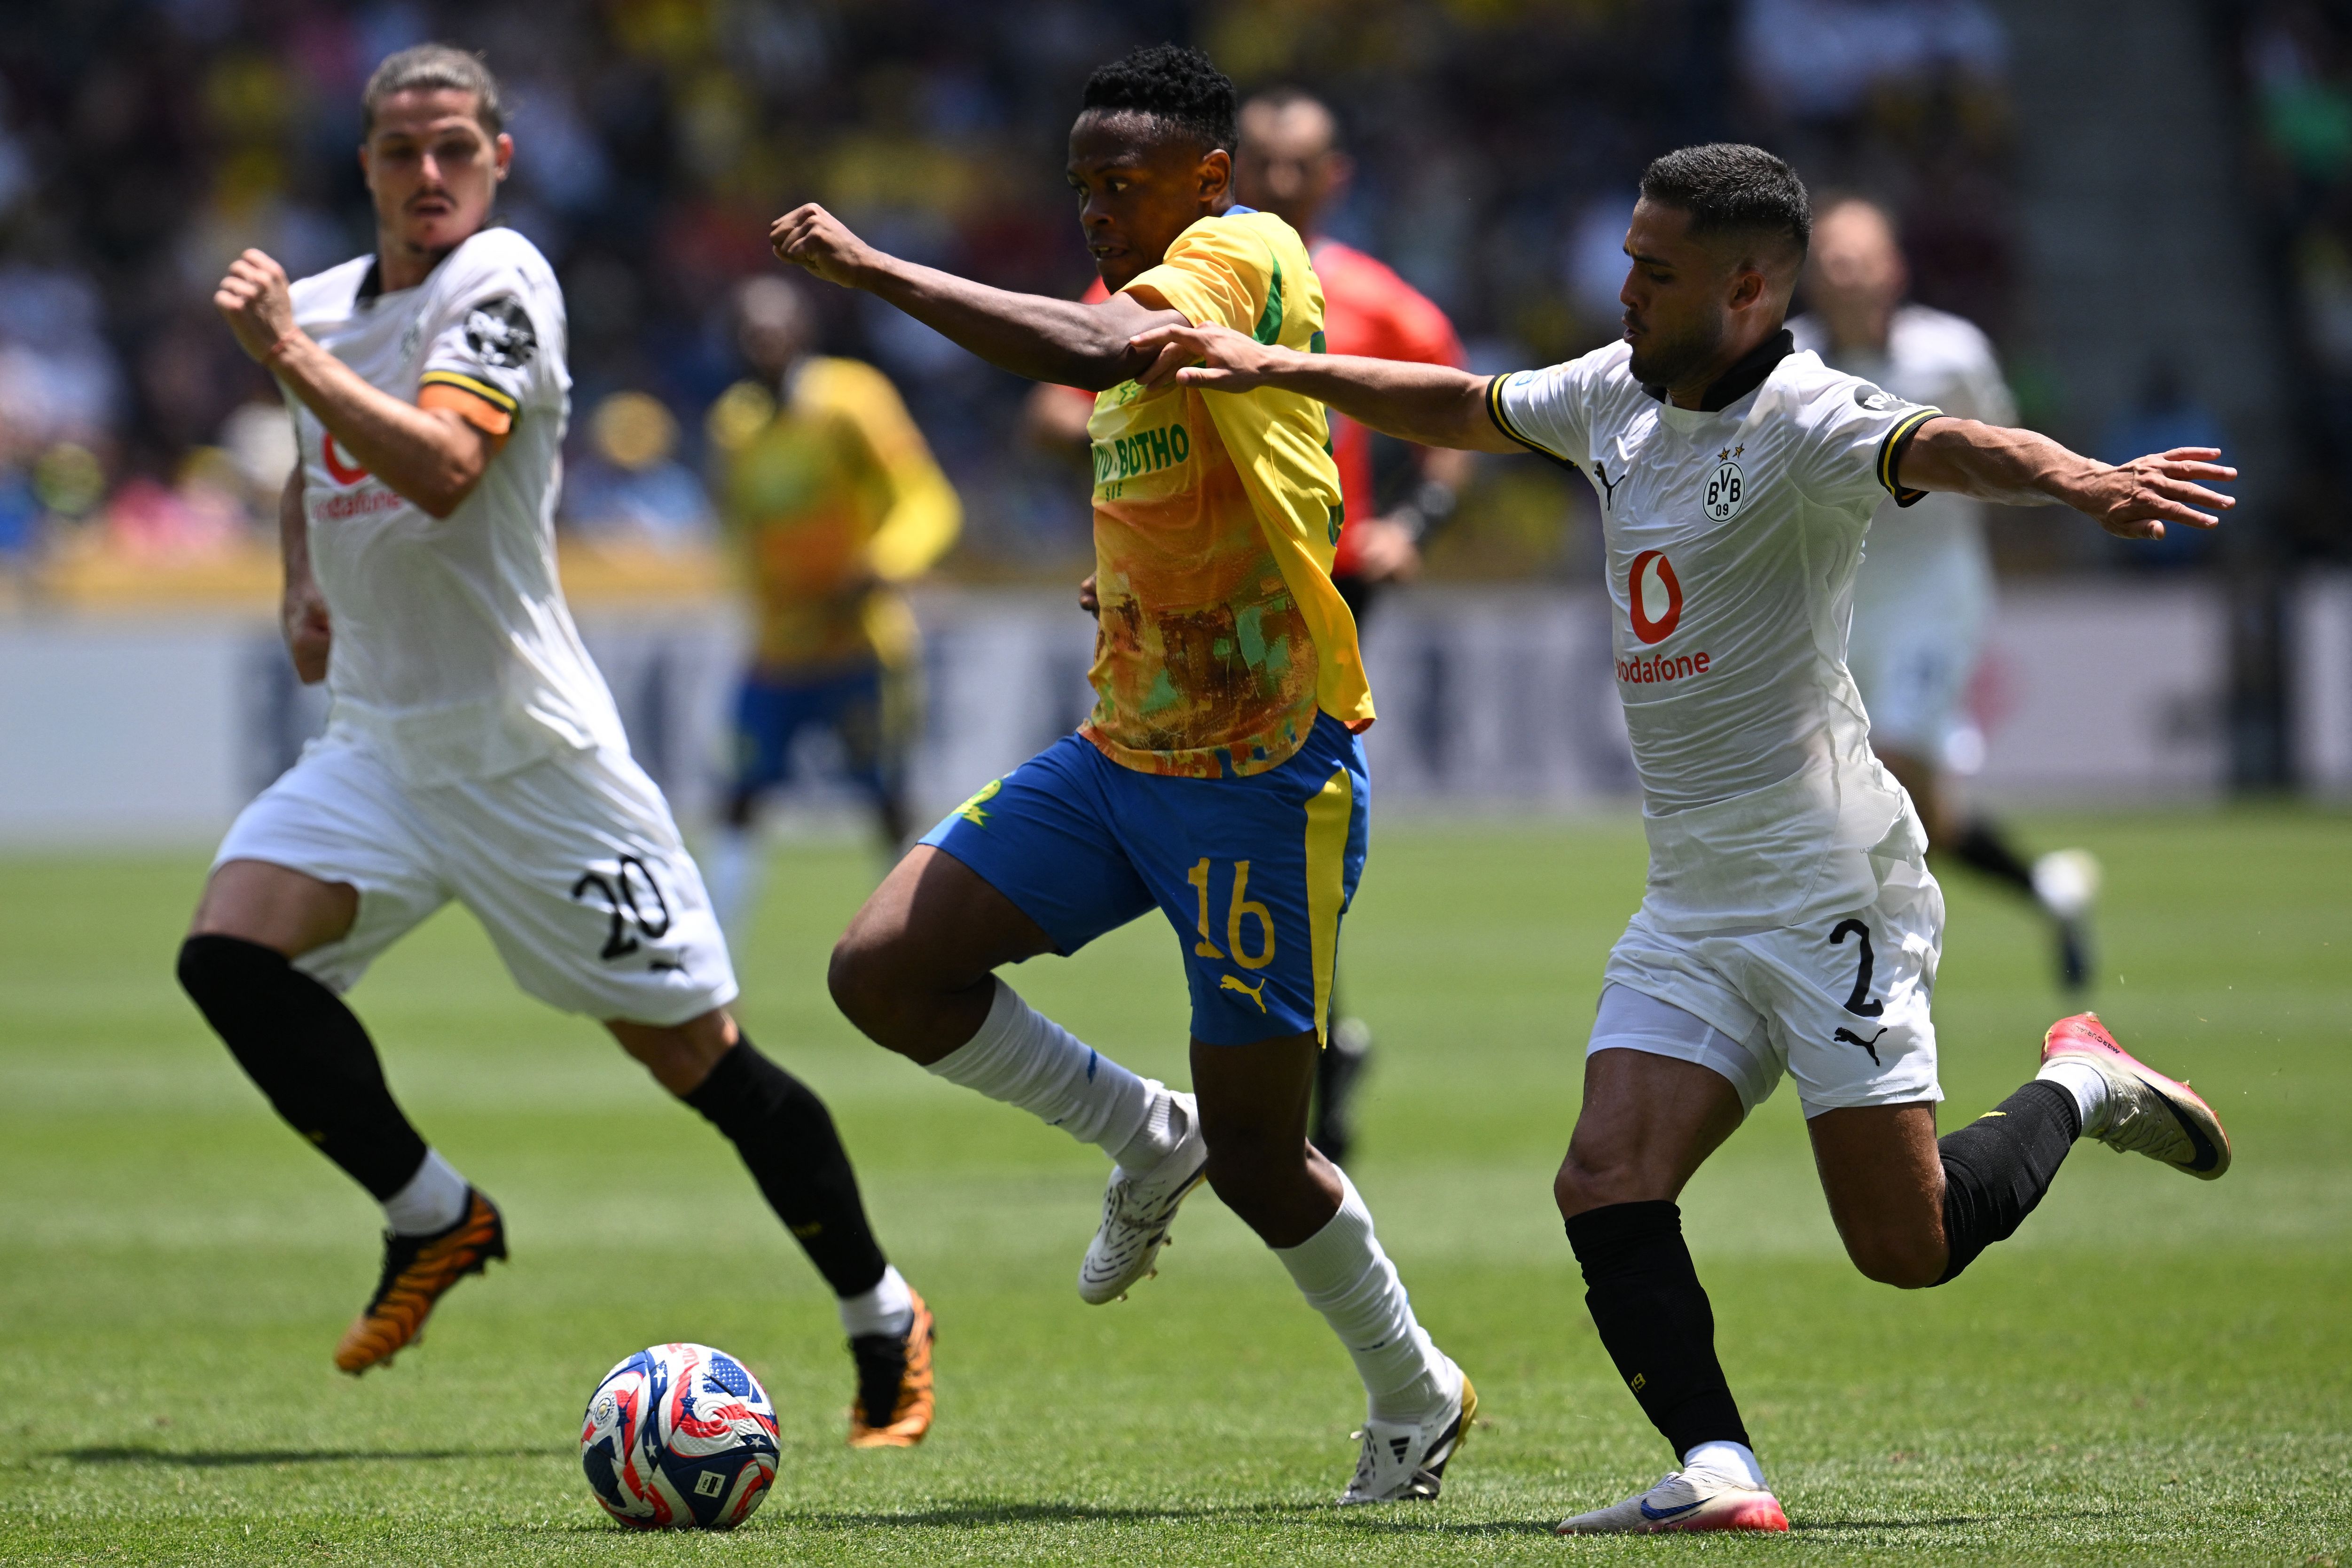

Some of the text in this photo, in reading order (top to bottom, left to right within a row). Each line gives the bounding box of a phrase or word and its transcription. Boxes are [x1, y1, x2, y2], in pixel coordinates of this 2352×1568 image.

[1707, 468, 1740, 506] BVB
[1716, 503, 1729, 517] 09
[1615, 651, 1710, 683] vodafone
[572, 855, 669, 960] 20
[1188, 857, 1275, 969] 16
[1829, 918, 1884, 1018] 2
